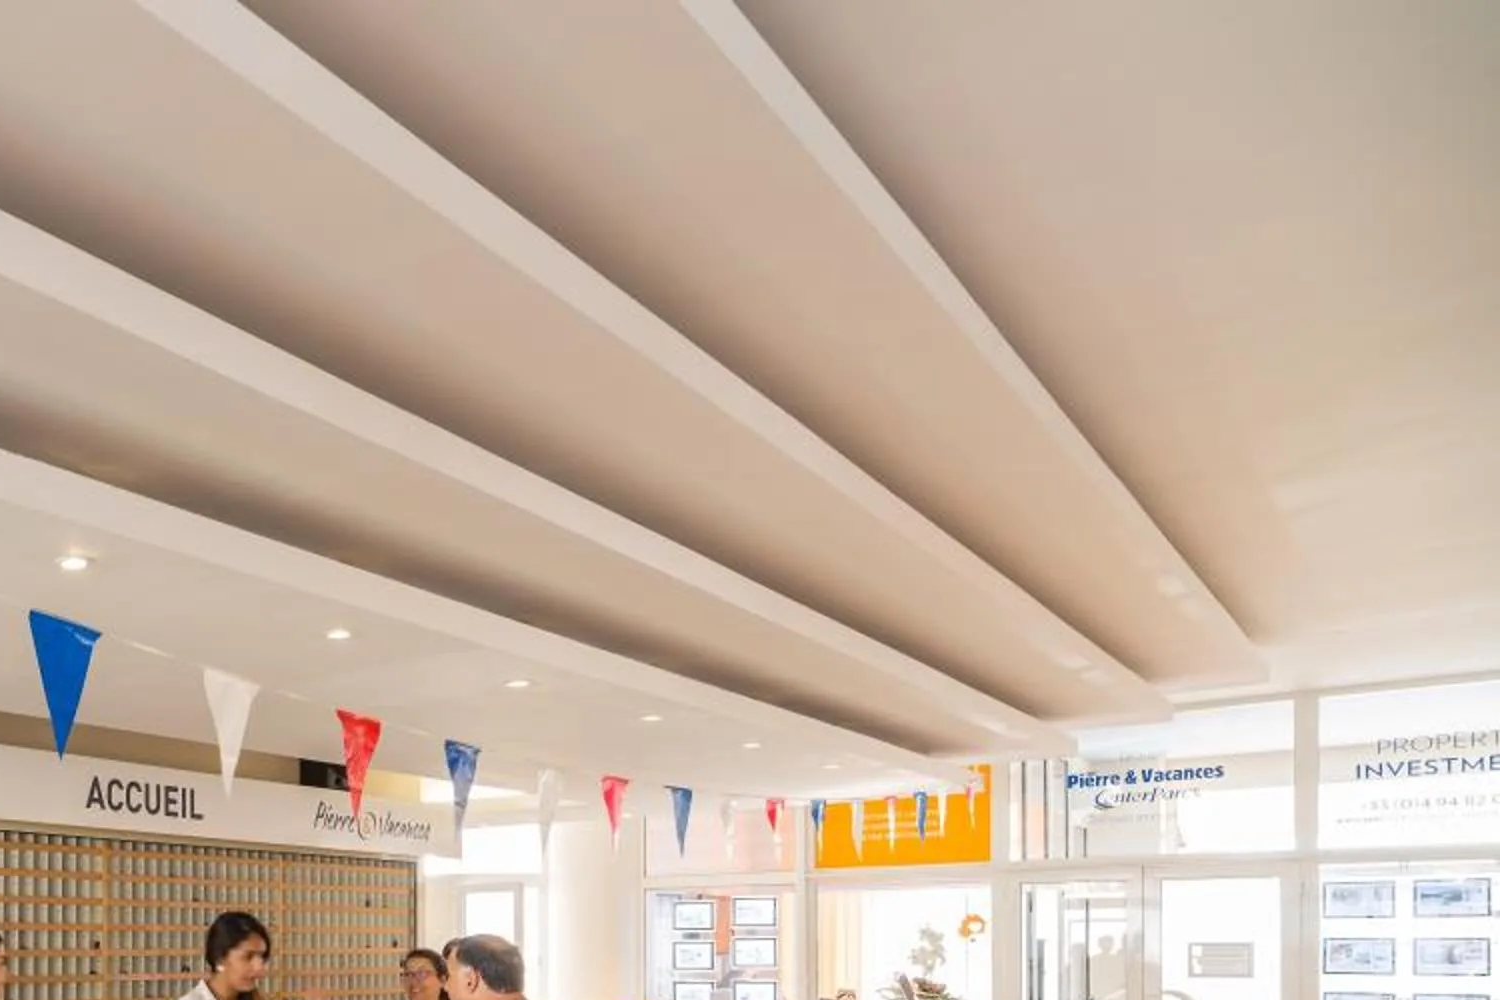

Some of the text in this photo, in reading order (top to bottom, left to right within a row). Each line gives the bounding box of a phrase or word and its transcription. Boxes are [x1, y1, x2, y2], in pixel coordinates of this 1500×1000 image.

[1376, 729, 1500, 755] PROPERT
[1067, 764, 1225, 789] Pierre & Vacances
[1355, 754, 1500, 780] INVESTME
[86, 775, 204, 821] ACCUEIL
